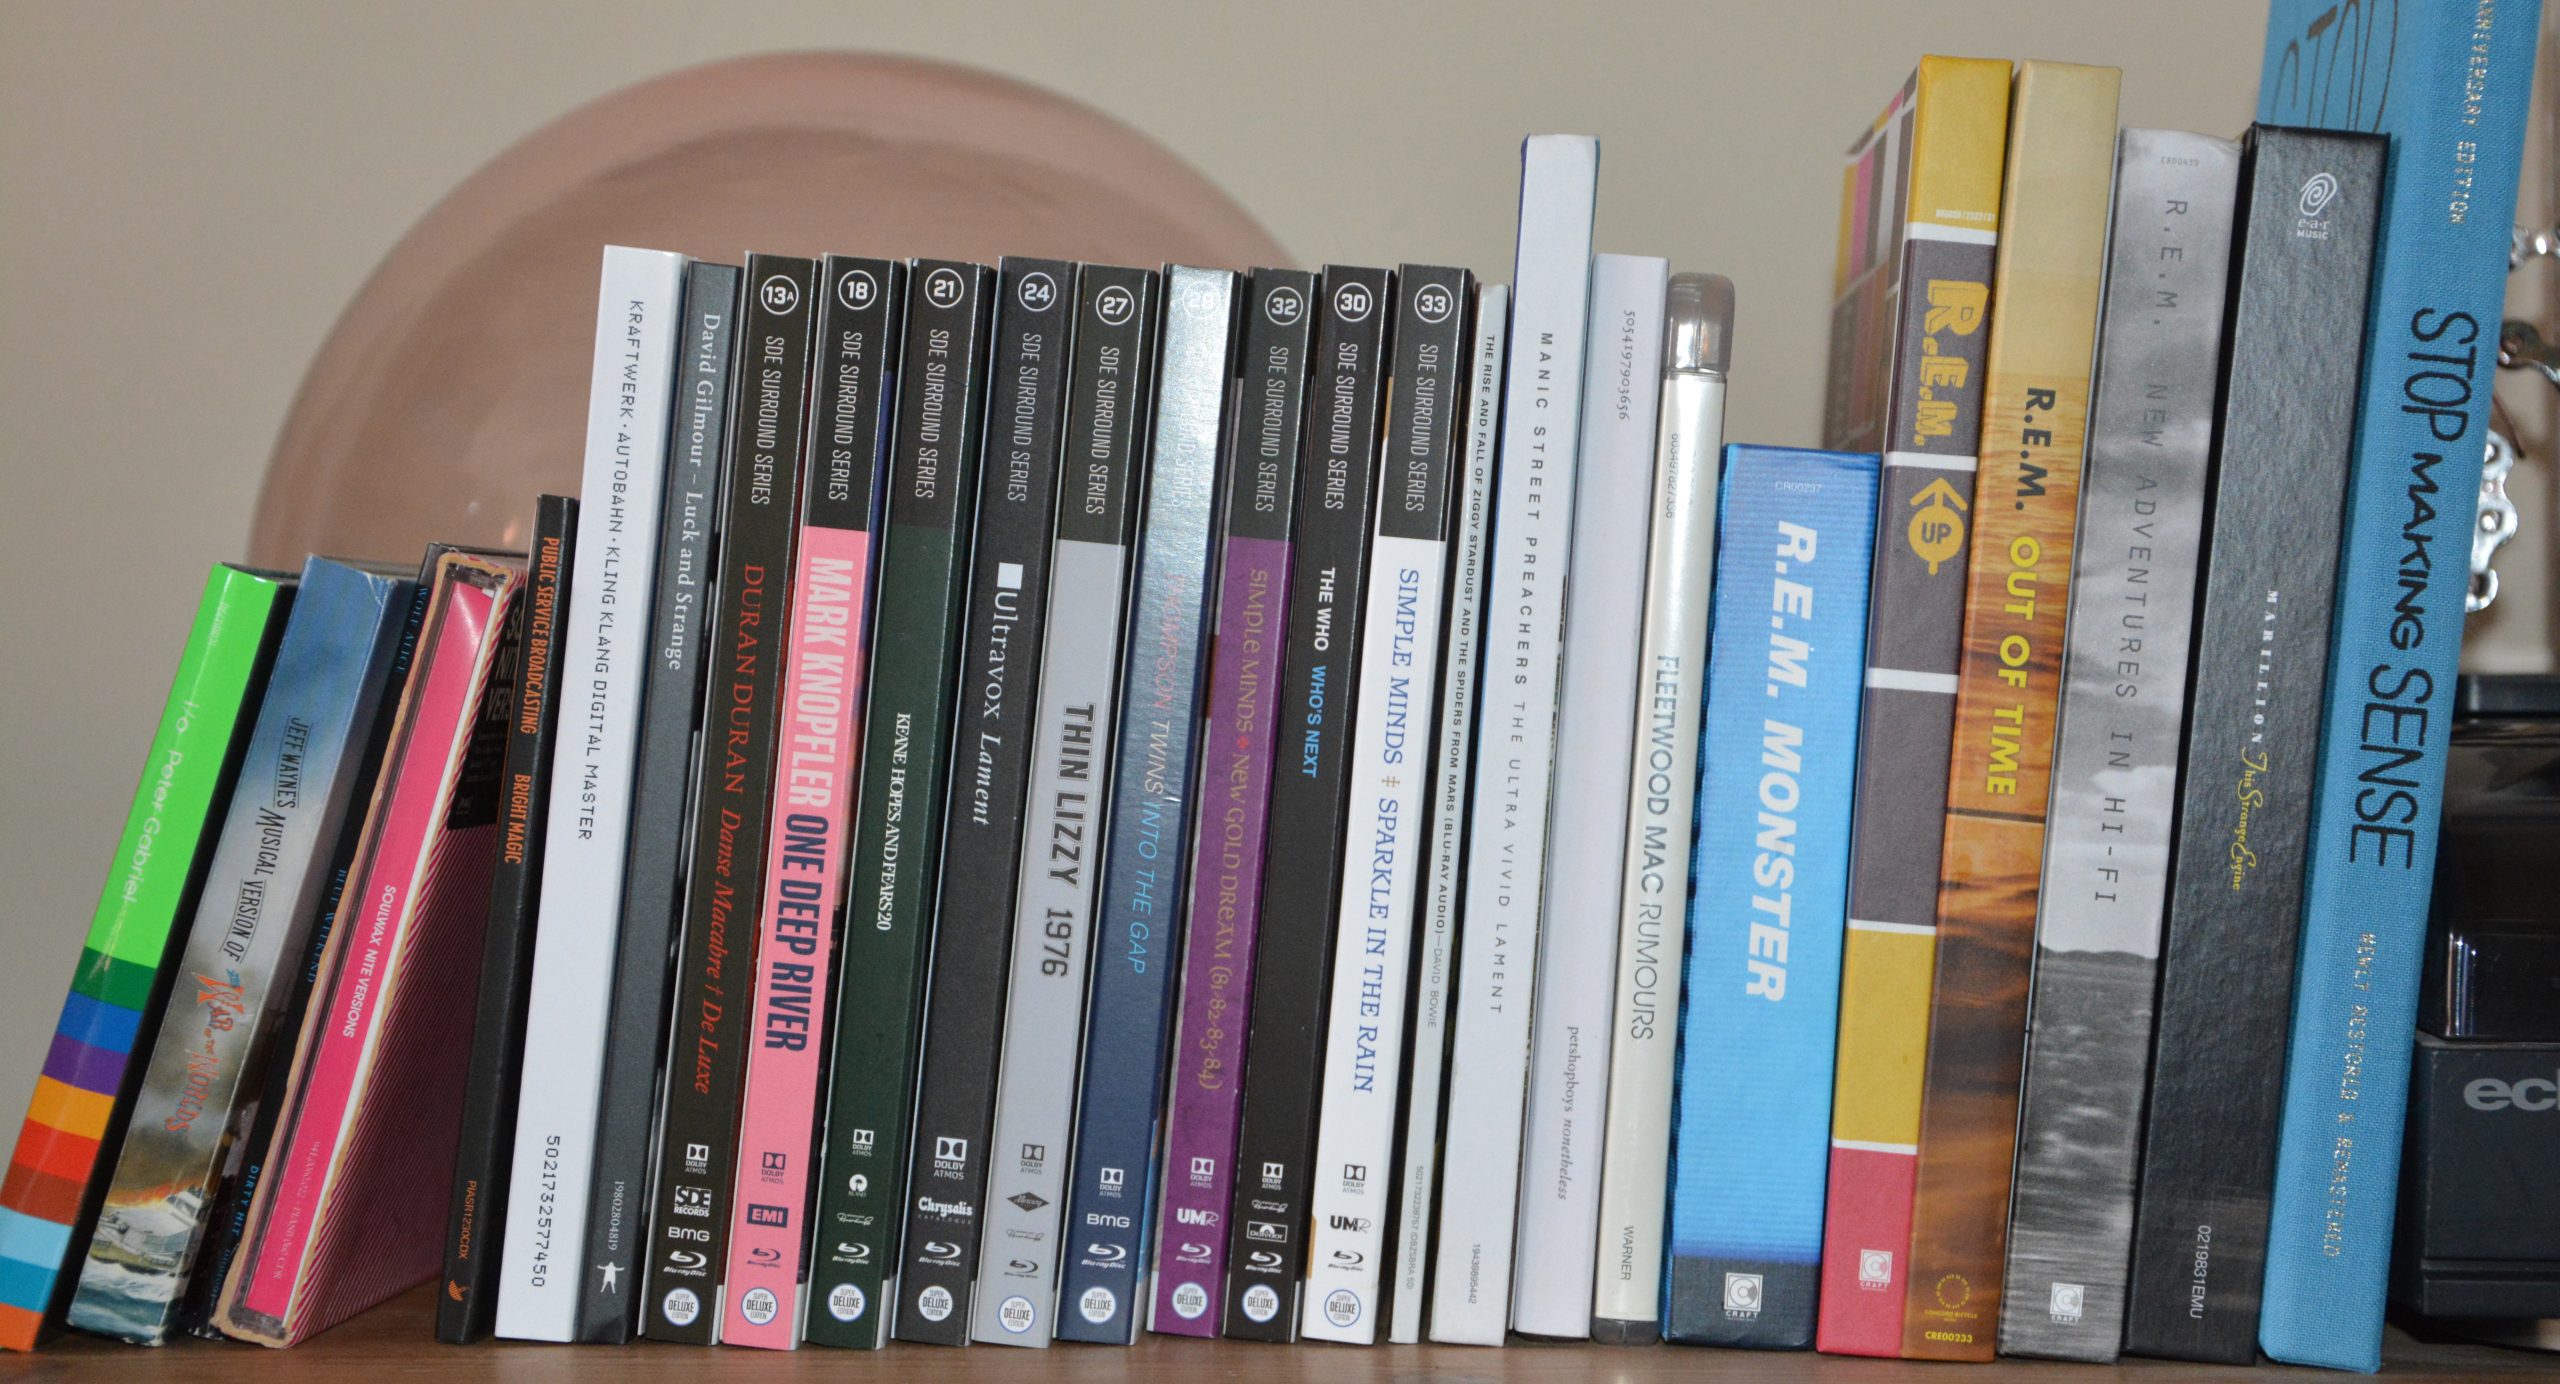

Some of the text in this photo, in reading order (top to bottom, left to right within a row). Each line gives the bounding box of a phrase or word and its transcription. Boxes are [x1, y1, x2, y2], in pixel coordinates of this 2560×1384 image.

[847, 281, 868, 300] 18
[934, 279, 955, 298] 21
[1024, 282, 1050, 302] 24
[1102, 296, 1128, 315] 27
[1271, 297, 1297, 316] 32
[1340, 293, 1366, 312] 30
[1421, 294, 1446, 313] 33
[2296, 229, 2329, 240] MUSIC
[750, 335, 785, 504] SDE SURROUND SERIES
[828, 330, 862, 500] SDE SURROUND SERIES
[914, 328, 949, 498] SDE SURROUND SERIES
[1006, 332, 1042, 501] SDE SURROUND SERIES
[1085, 345, 1120, 514] SDE SURROUND SERIES
[1254, 345, 1289, 512] SDE SURROUND SERIES
[1324, 341, 1358, 509] SDE SURROUND SERIES
[1404, 343, 1438, 511] SDE SURROUND SERIES
[1915, 280, 1987, 444] R.E.M.
[578, 300, 643, 839] KRAFTWERK AUTOBAHN KLING KLANG DIGITAL MASTER
[664, 313, 720, 669] David Gilmour Luck and Strange
[1921, 521, 1952, 545] UP
[2094, 198, 2187, 902] R.E.M. NEW ADVENTURES IN HI-FI
[1987, 387, 2055, 794] R.E.M. OUT OF TIME
[2251, 590, 2278, 742] MARILLION
[2349, 308, 2478, 867] STOP MAKING SENSE
[504, 536, 559, 863] PUBLIC SERVICE BROADCASTING BRIGHT MAGIC
[972, 591, 1018, 824] Ultravox Lament
[1302, 566, 1335, 777] THE WHO WHO'S NEXT
[1426, 335, 1495, 1027] THE RISE AND FALL OF ZIGGY STARDUST AND THE SPIDERS FROM MARS BOWIE
[1490, 332, 1553, 1013] MANIC STREET PREACHERS THE ULTRA VIVID LAMENT
[122, 749, 183, 902] Peter Gabriel
[223, 717, 308, 962] JEFF WAYNE'S MUSICAL VERSION OF
[694, 564, 764, 1093] DURAN DURAN Danse Macabre De Luxe
[765, 557, 852, 1051] MARK KNOPFLER ONE DEEP RIVER
[886, 712, 911, 821] KEANE HOPES
[1041, 704, 1094, 976] THIN LIZZY 1976
[1127, 571, 1187, 973] THOMPSON TWINS INTO THE GAP
[1222, 659, 1259, 869] MINDS GOLD
[1353, 568, 1419, 1092] SIMPLE MINDS SPARKLE IN THE RAIN
[1747, 521, 1816, 999] R.E.M. MONSTER
[2230, 746, 2268, 890] This Strange Engine
[1630, 655, 1679, 1039] FLEETWOOD MAC RUMOURS
[342, 884, 396, 1037] SOULWAX NITE VERSIONS
[933, 1169, 964, 1180] ATMOS
[934, 1160, 965, 1171] DOLBY
[1557, 1025, 1581, 1199] petshopboys nonetheless
[231, 1164, 260, 1234] DIRTY HIT
[531, 1135, 560, 1287] 5021732577450
[668, 1226, 710, 1242] BMG
[751, 1207, 785, 1225] EMI
[918, 1196, 973, 1218] Chrysalis
[1620, 1225, 1634, 1280] WARNER
[2189, 1224, 2211, 1318] 0219831EMU
[922, 1296, 949, 1310] DELUXE
[1329, 1300, 1357, 1314] DELUXE
[1725, 1310, 1758, 1319] CRAFT
